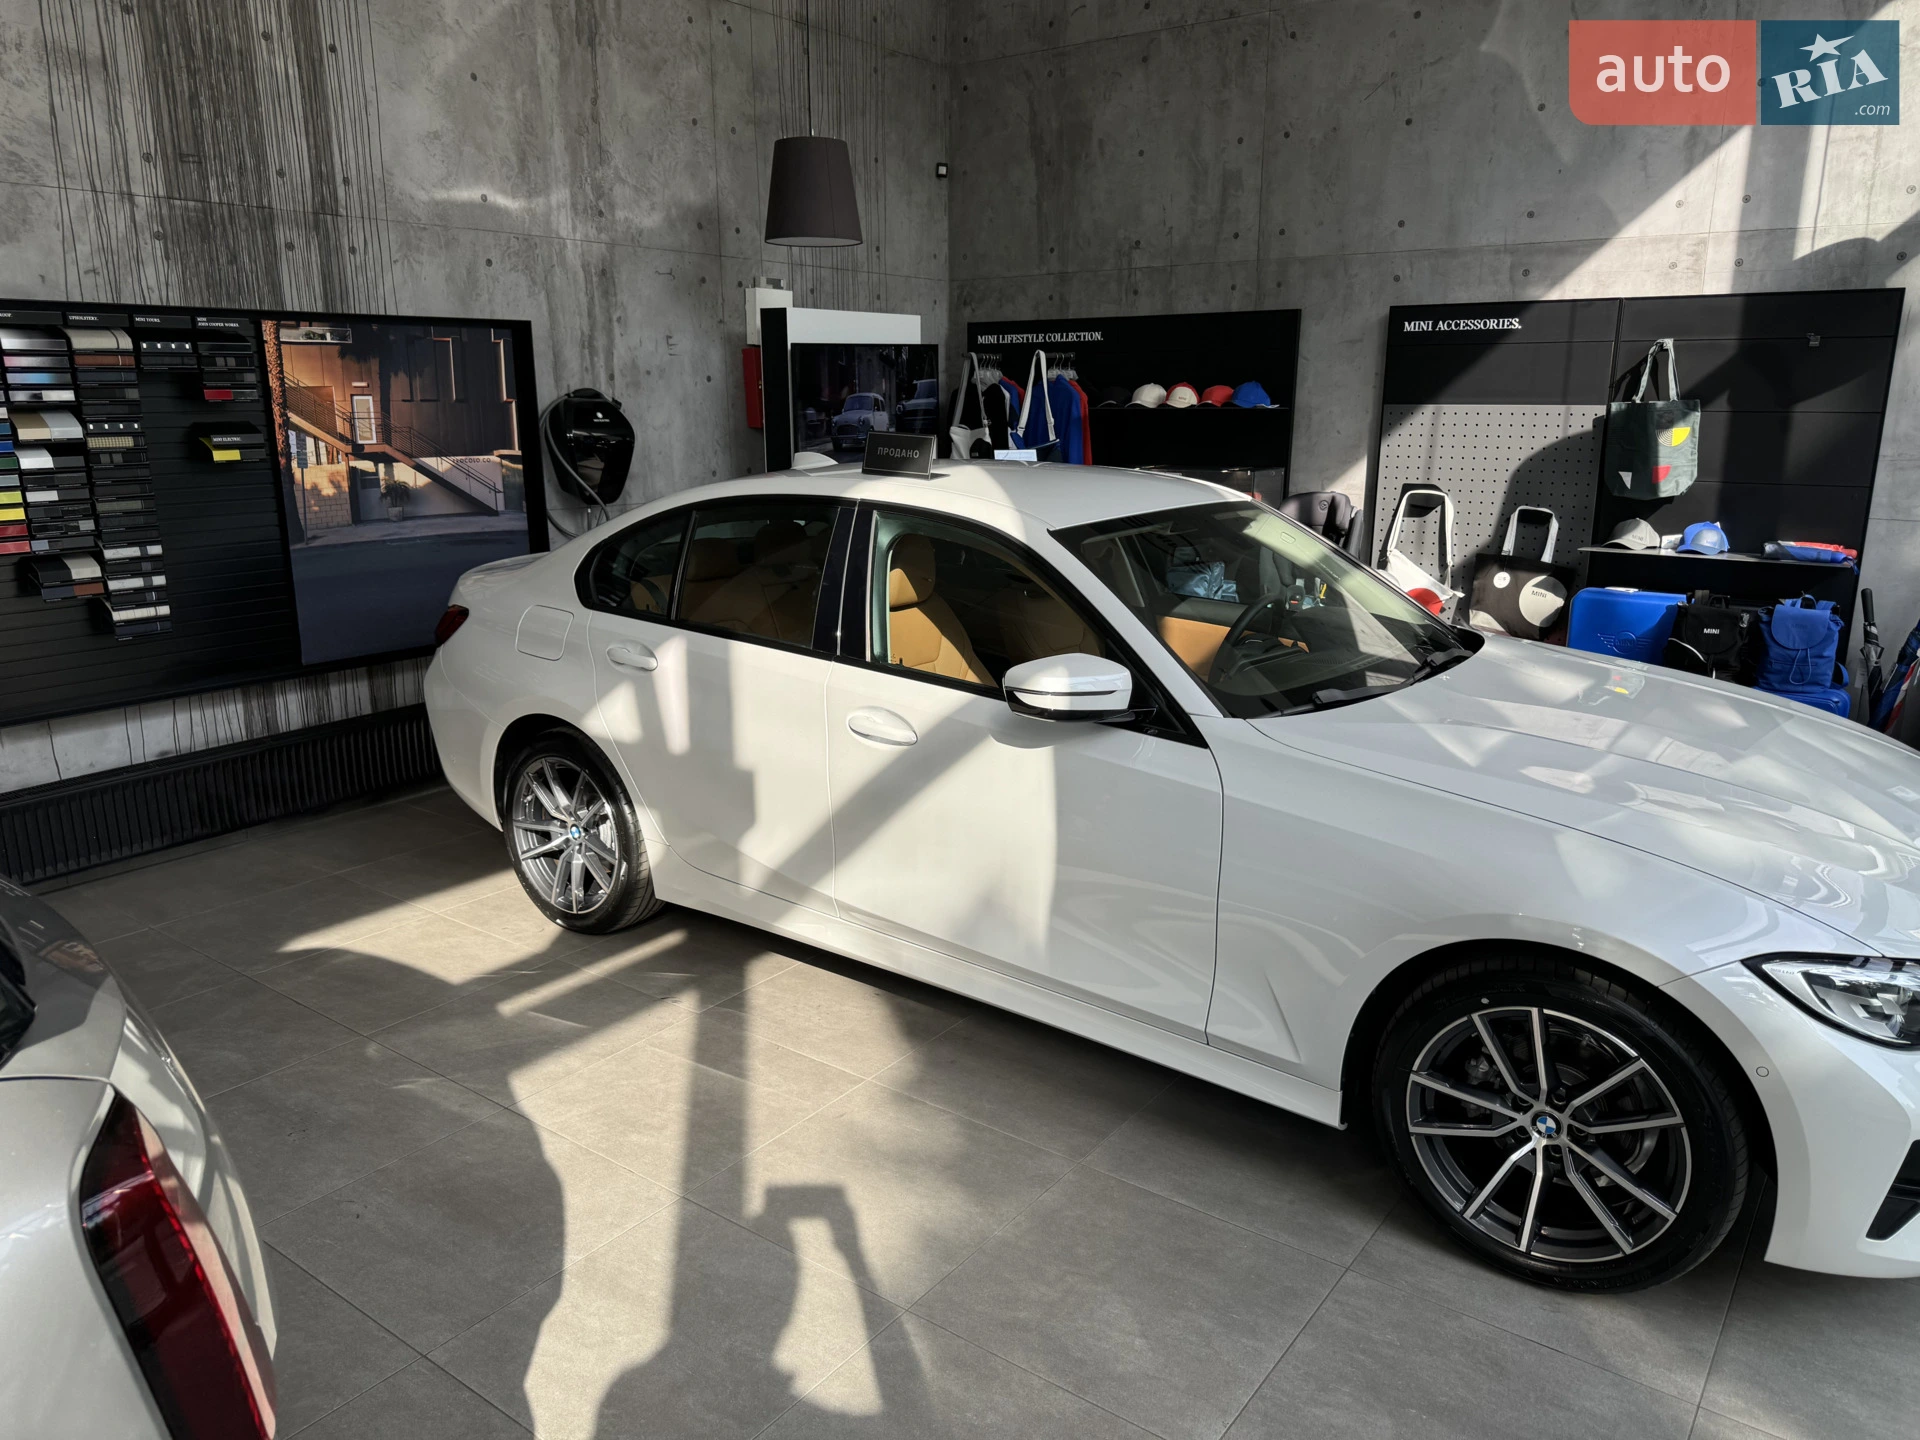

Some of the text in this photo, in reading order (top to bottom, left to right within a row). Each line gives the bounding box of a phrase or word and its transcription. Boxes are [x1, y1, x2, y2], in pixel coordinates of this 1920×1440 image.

[1403, 317, 1523, 332] MINI ACCESSORIES.
[977, 331, 1104, 344] MINI LIFESTYLE COLLECTION.
[877, 446, 920, 459] ПРОДАНО
[1531, 590, 1547, 599] MINI
